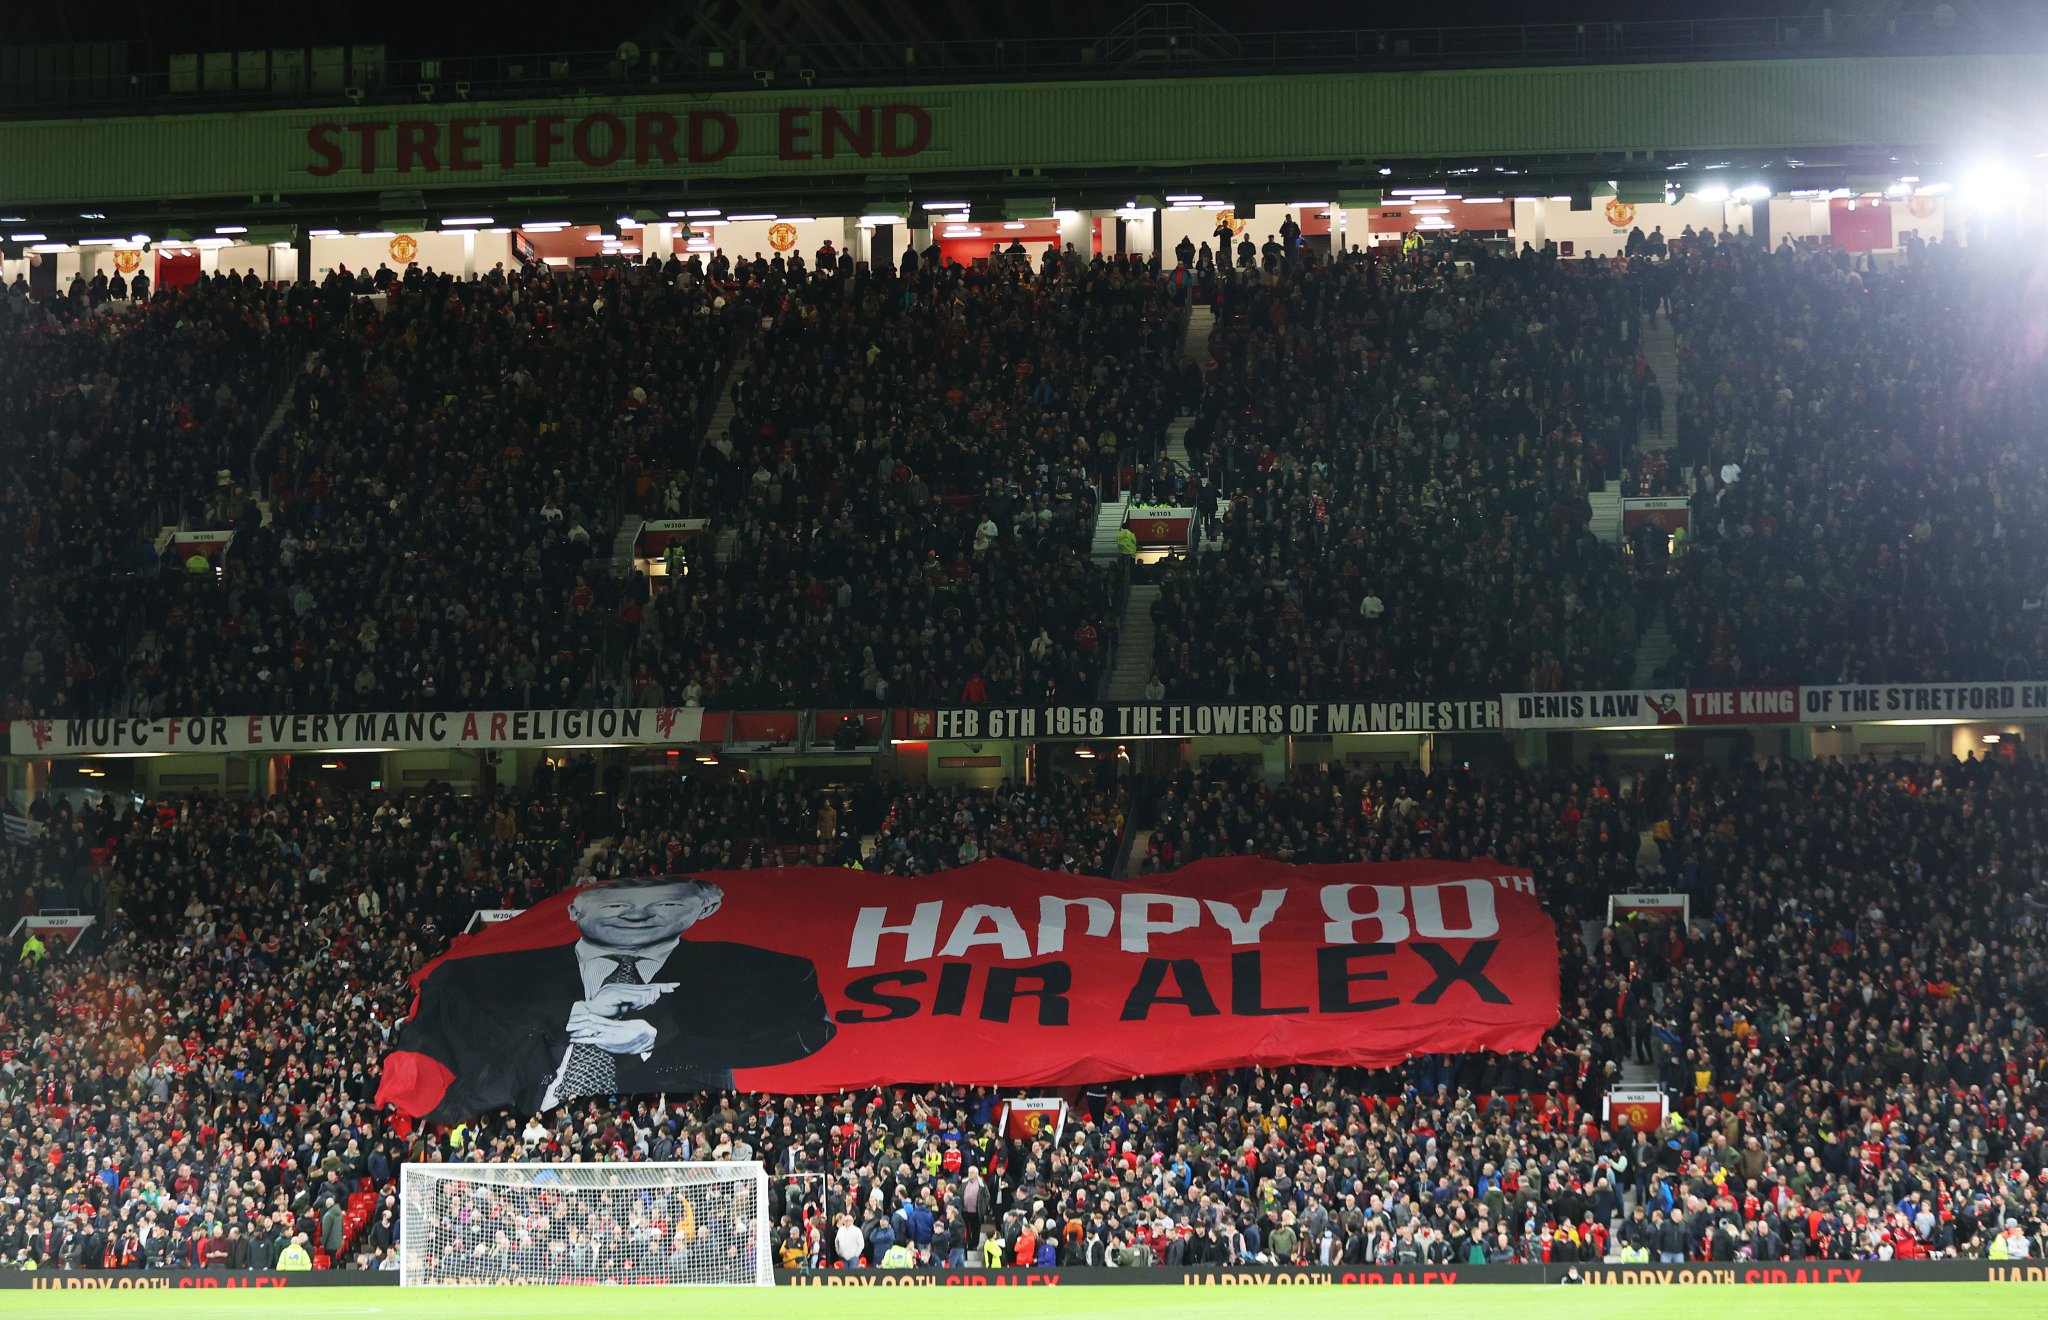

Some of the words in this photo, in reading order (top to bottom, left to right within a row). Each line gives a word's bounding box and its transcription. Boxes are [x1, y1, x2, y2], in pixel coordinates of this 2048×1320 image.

[306, 110, 739, 178] STRETFORD
[778, 103, 933, 162] END
[936, 708, 979, 738] FEB
[988, 707, 1036, 738] 6TH
[1044, 706, 1104, 736] 1958
[1117, 706, 1162, 735] THE
[1169, 704, 1284, 735] FLOWERS
[1289, 704, 1319, 733] OF
[1327, 700, 1500, 733] MANCHESTER
[1518, 696, 1584, 719] DENIS
[1590, 694, 1639, 718] LAW
[1692, 692, 1734, 716] THE
[1740, 690, 1793, 714] KING
[1806, 690, 1833, 713] OF
[1839, 689, 1880, 712] THE
[1886, 686, 2014, 711] STRETFORD
[847, 888, 1288, 967] HAPPY
[835, 961, 1072, 1026] SIR
[1120, 940, 1513, 1022] ALEX
